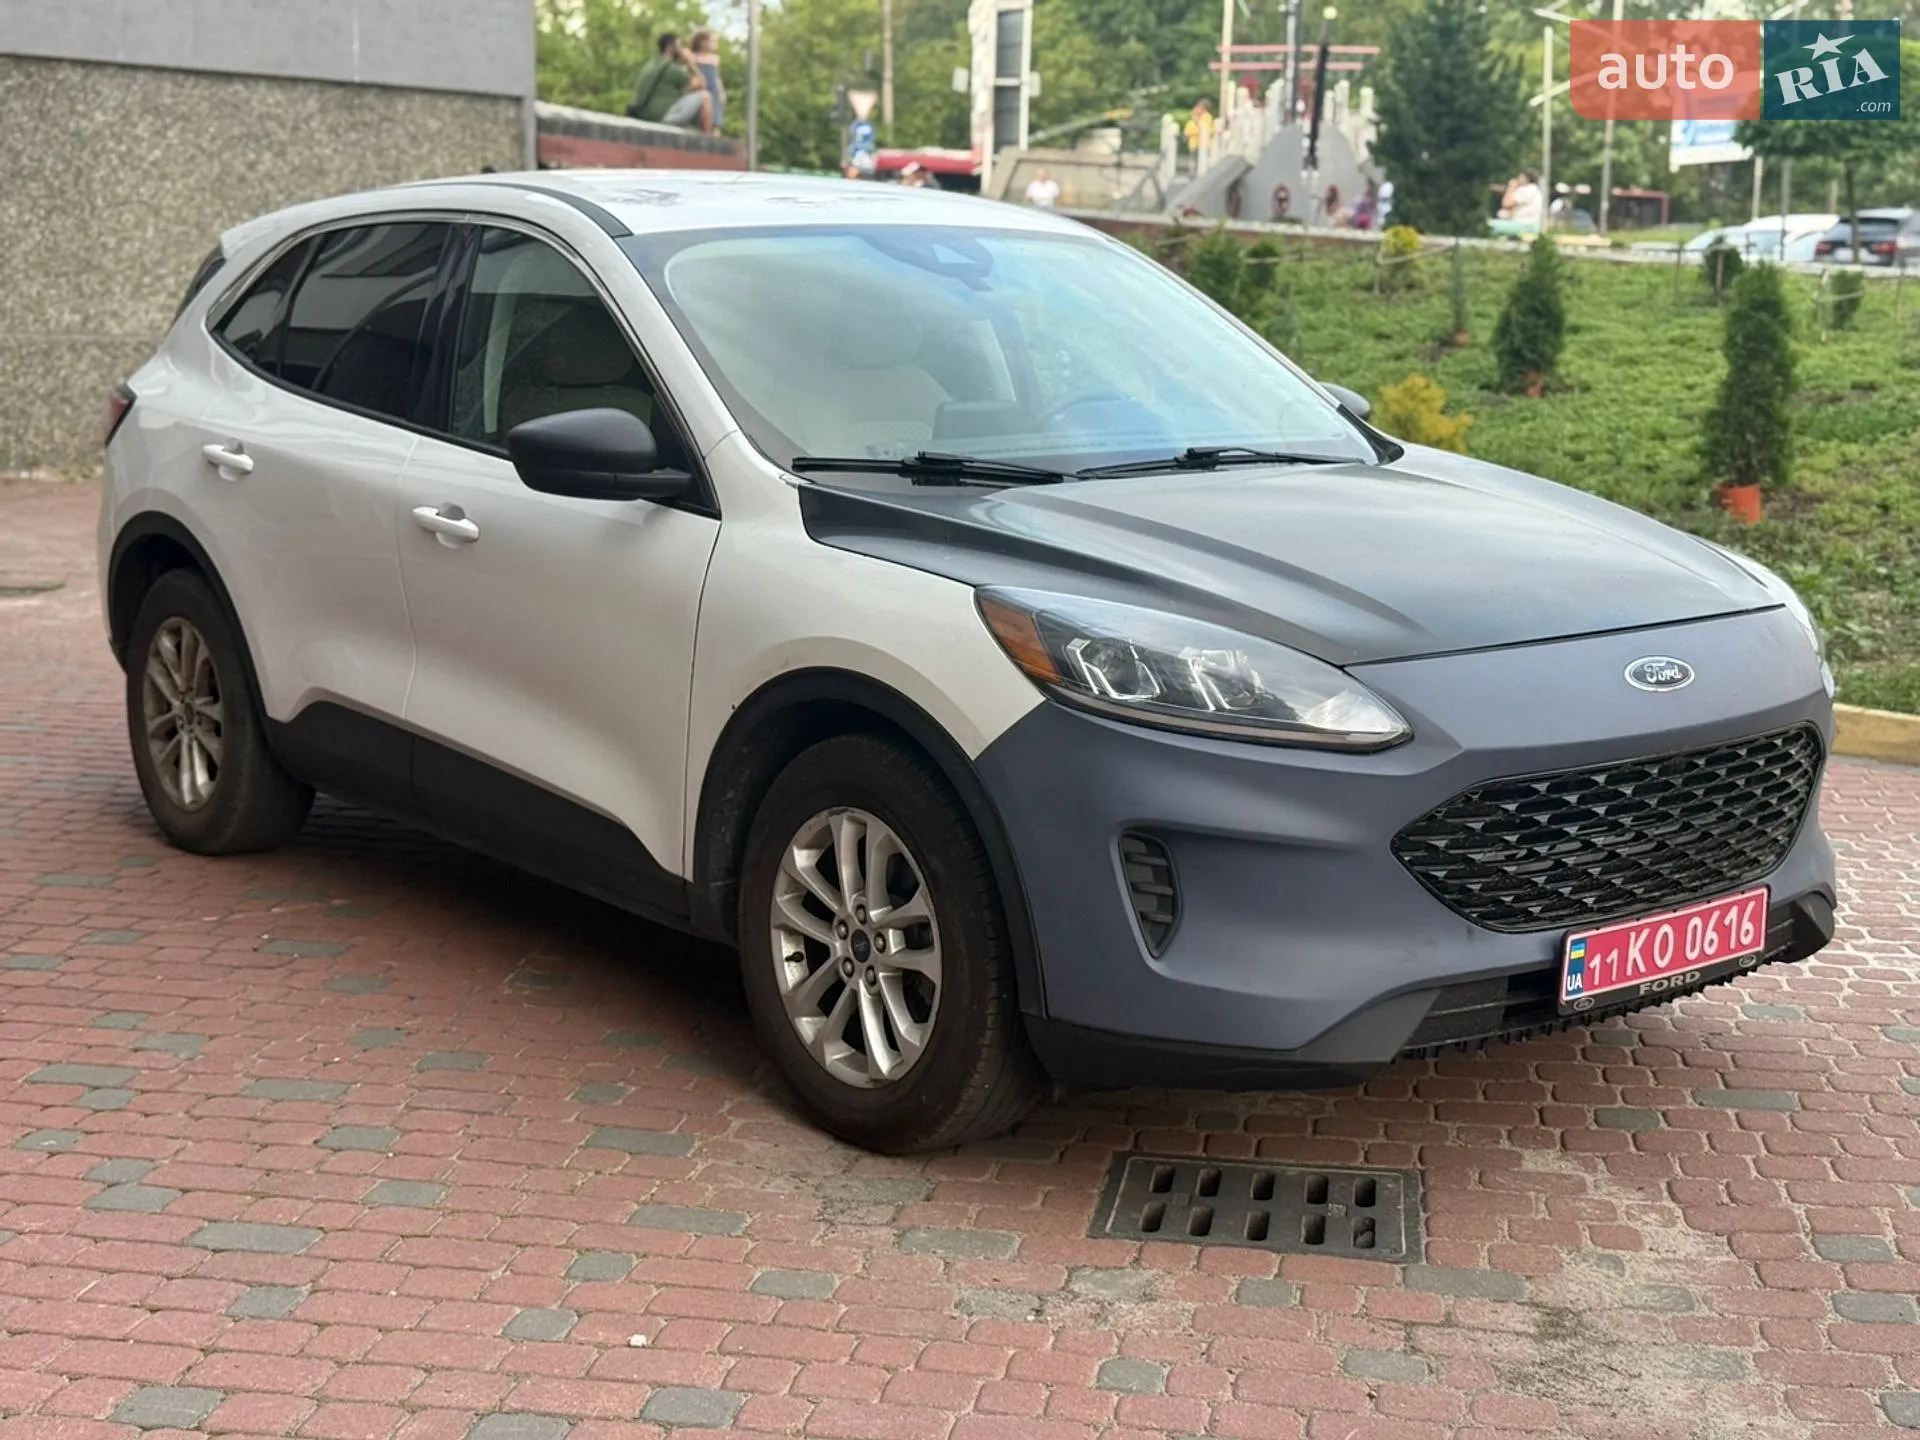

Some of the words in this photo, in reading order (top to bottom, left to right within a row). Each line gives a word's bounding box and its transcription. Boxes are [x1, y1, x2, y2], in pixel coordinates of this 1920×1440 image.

[1643, 661, 1681, 683] Ford
[1685, 901, 1756, 961] 0616
[1567, 973, 1583, 991] UA
[1639, 971, 1701, 996] FORD
